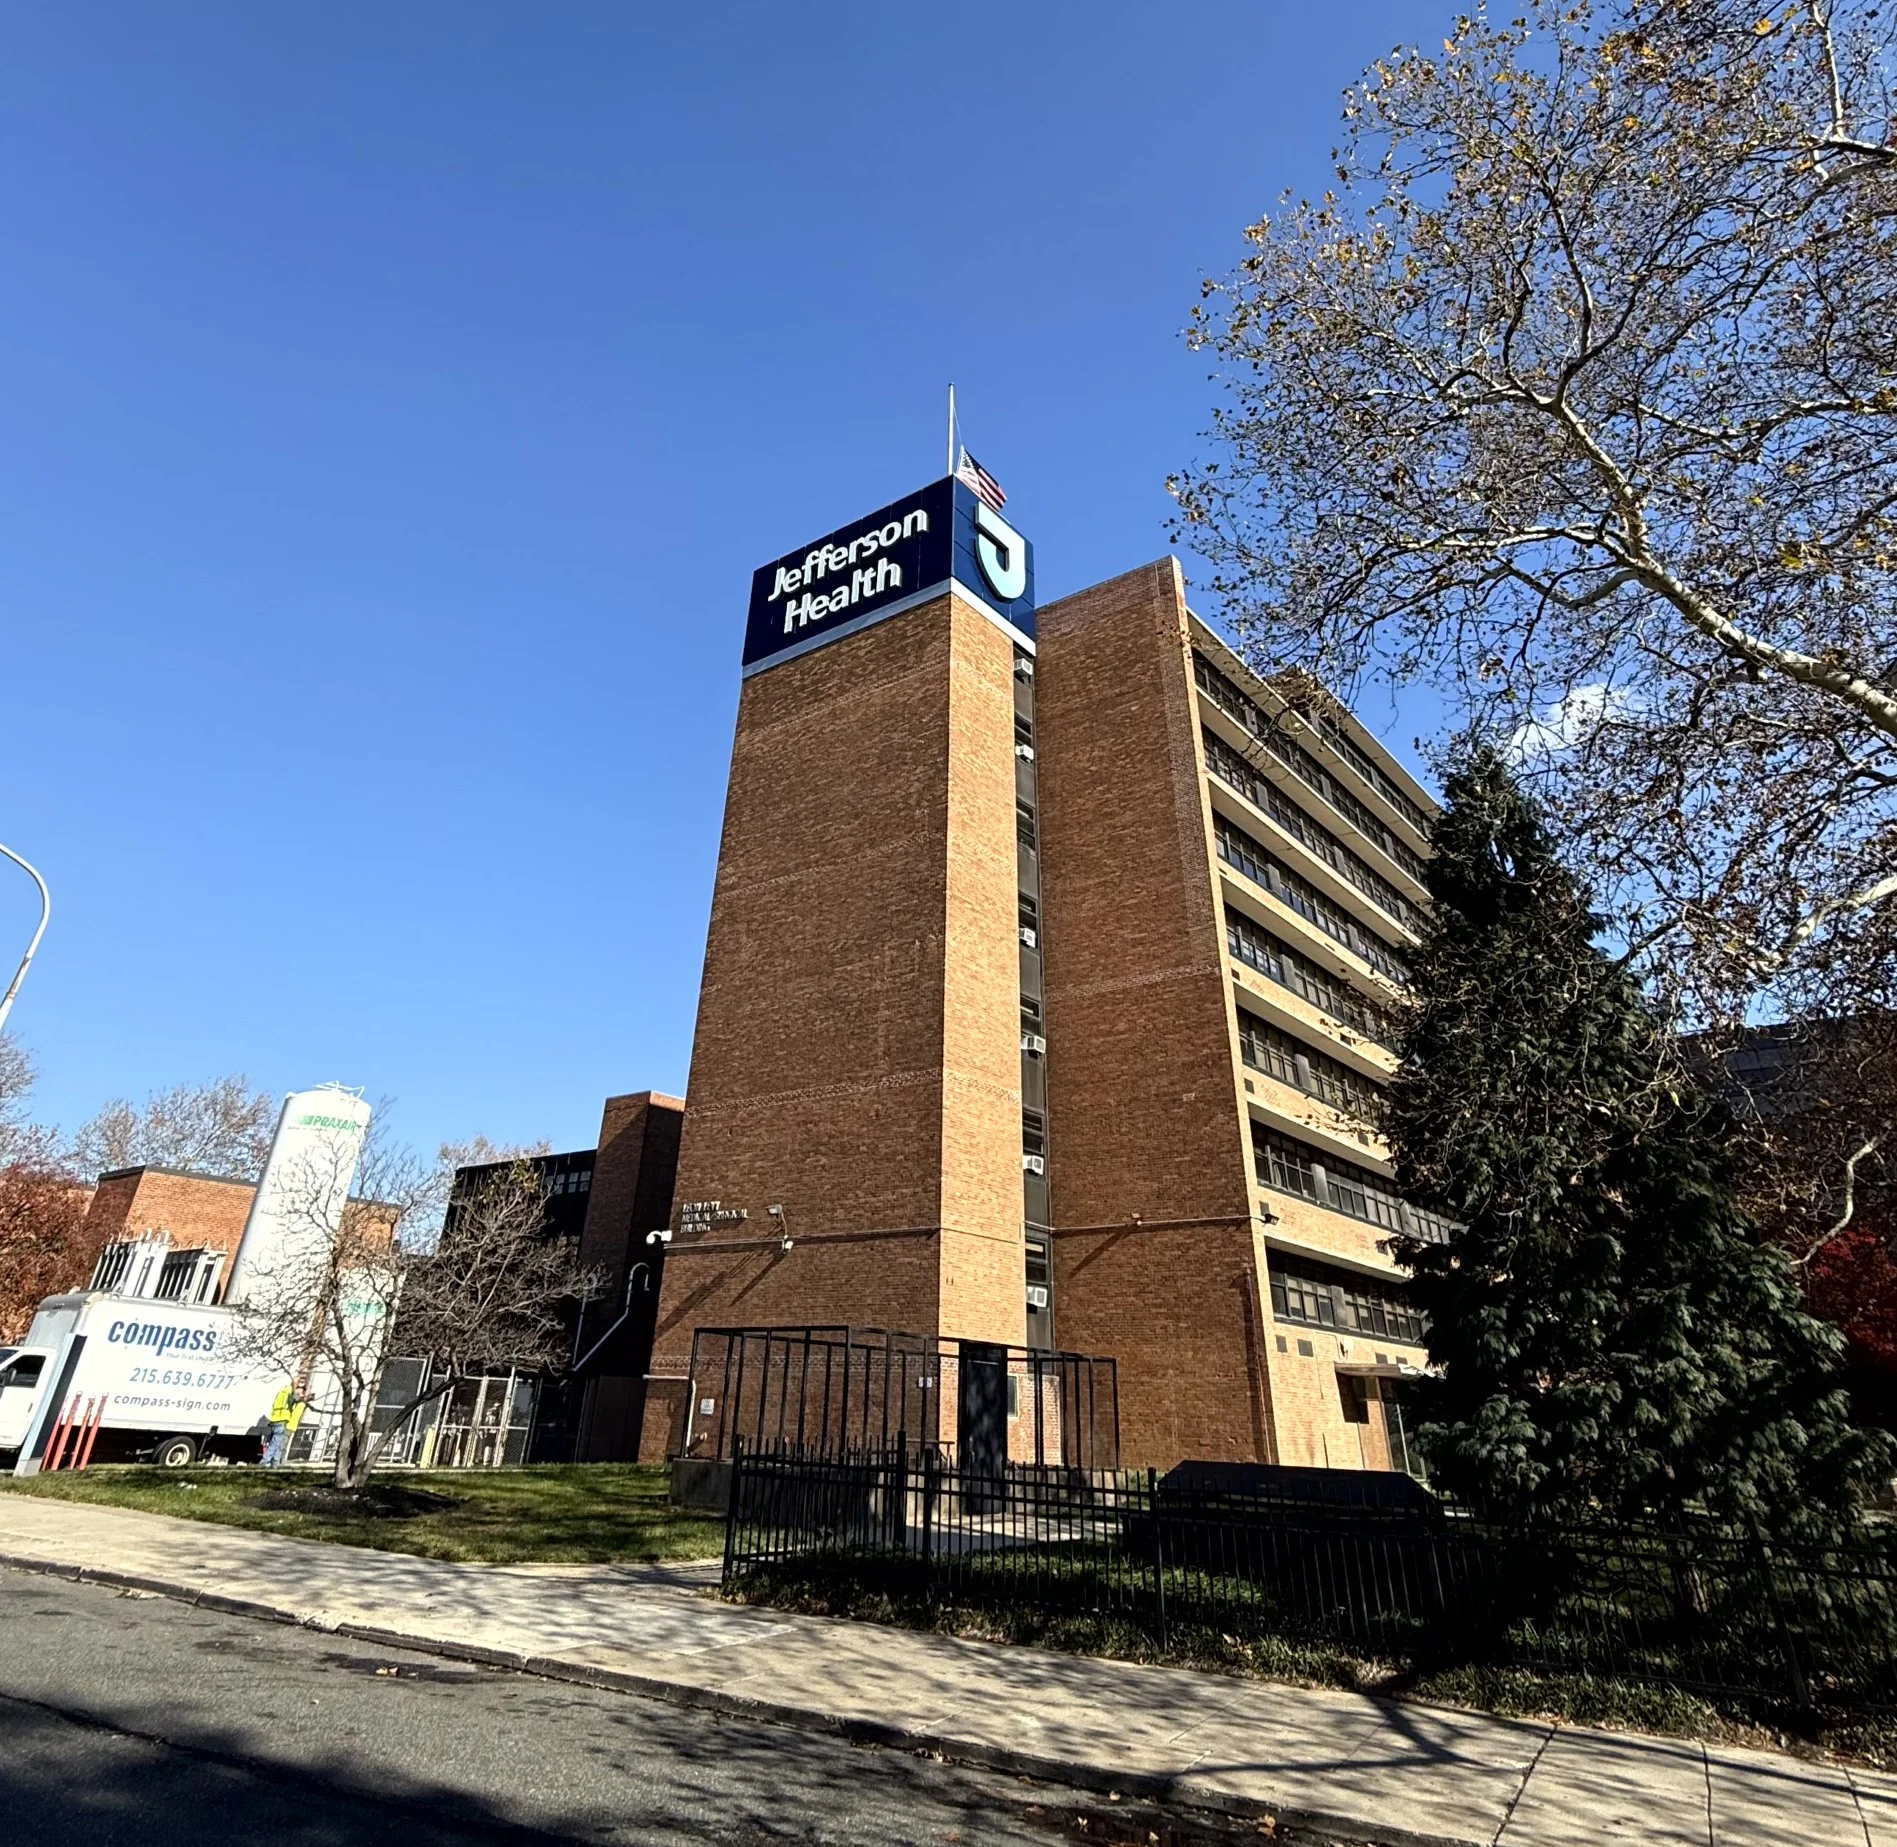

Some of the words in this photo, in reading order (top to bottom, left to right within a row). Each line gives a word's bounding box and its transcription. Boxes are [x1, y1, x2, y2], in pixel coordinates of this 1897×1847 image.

[768, 508, 928, 602] Jefferson
[784, 557, 902, 634] Health
[313, 1115, 358, 1133] PRAXAIR
[107, 1320, 217, 1356] compass
[129, 1367, 235, 1390] 215.639.6777
[113, 1394, 231, 1411] compass-sign.com
